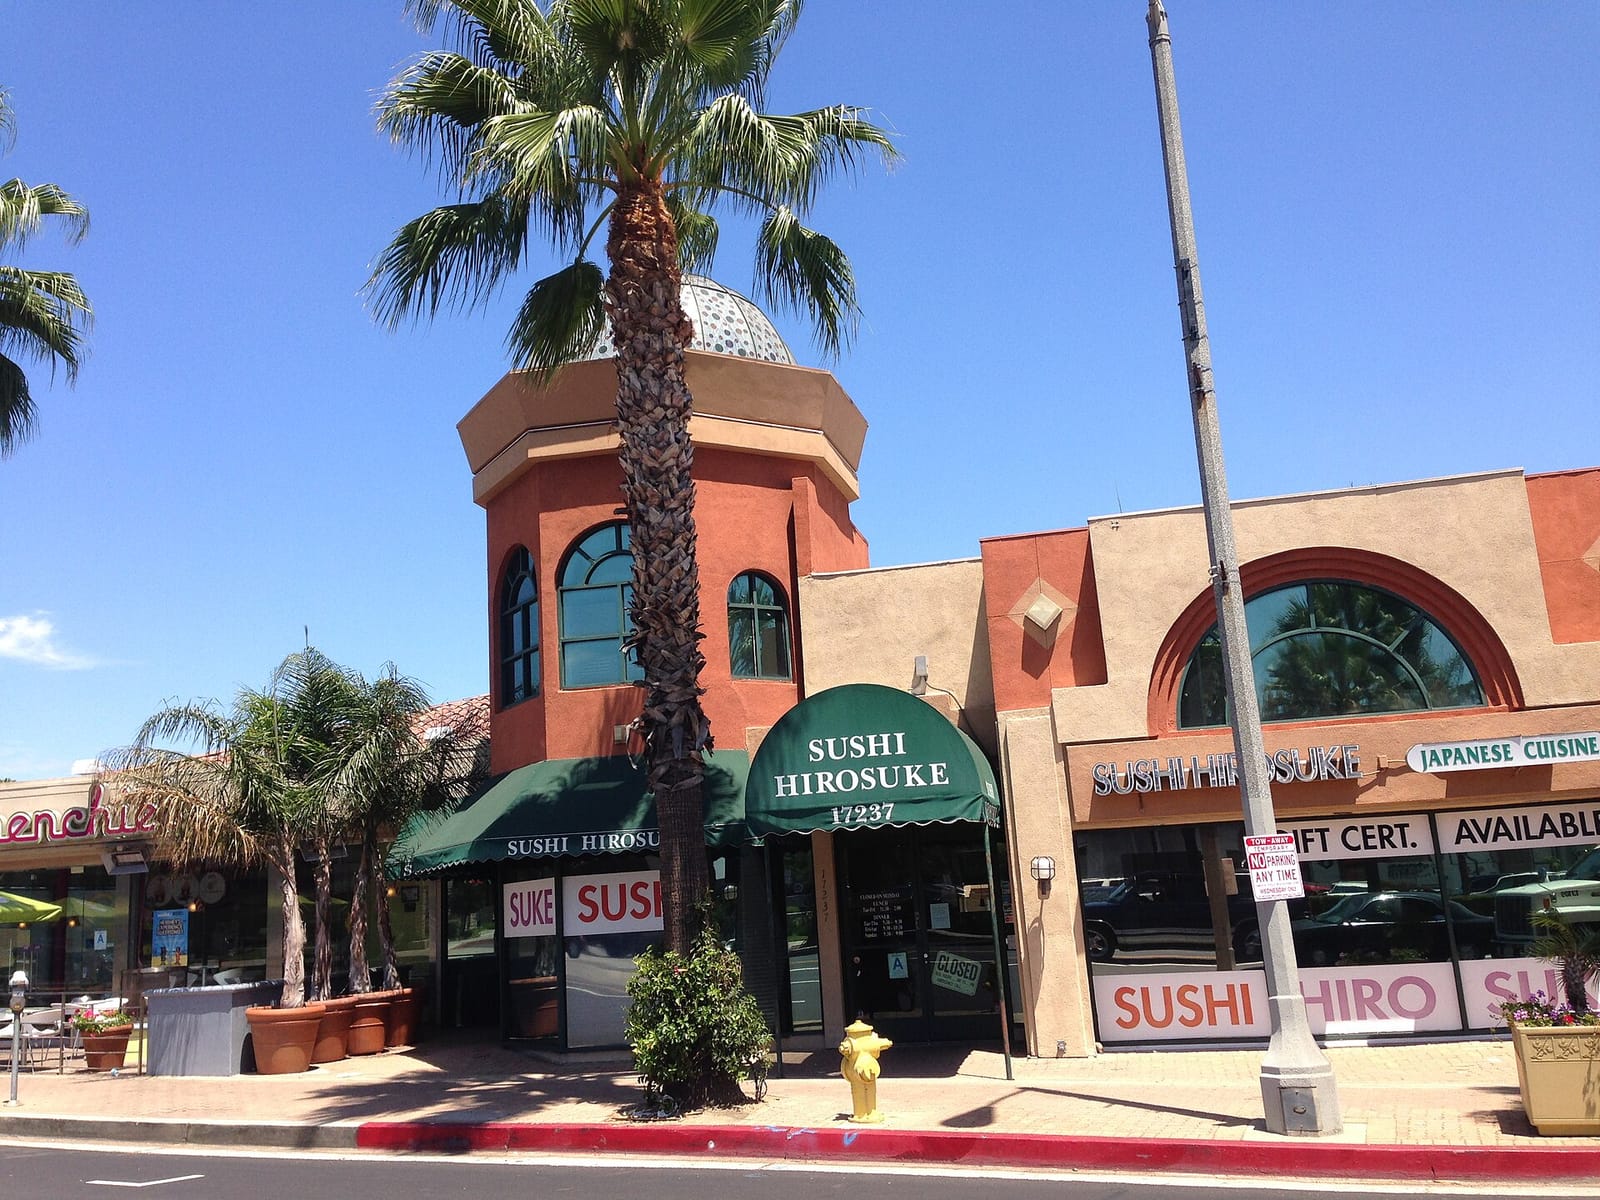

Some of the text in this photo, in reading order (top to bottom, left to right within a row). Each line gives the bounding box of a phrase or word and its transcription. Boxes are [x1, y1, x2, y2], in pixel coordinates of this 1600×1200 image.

[808, 732, 907, 763] SUSHI
[1420, 736, 1600, 772] JAPANESE CUISINE
[774, 762, 950, 798] HIROSUKE
[1092, 756, 1188, 796] SUSHI
[0, 782, 158, 844] enchie
[830, 802, 896, 826] 17237
[507, 831, 661, 856] SUSHI HIROSU
[1251, 836, 1289, 847] TOW-AWAY
[1277, 823, 1418, 854] IFT CERT.
[1250, 853, 1296, 869] NO PARKING
[1256, 869, 1298, 883] ANY TIME
[509, 888, 554, 928] SUKE
[577, 881, 662, 923] SUS
[97, 934, 104, 944] A
[892, 957, 904, 971] A
[937, 954, 979, 981] CLOSED
[1114, 982, 1254, 1030] SUSHI
[1299, 975, 1437, 1022] HIRO
